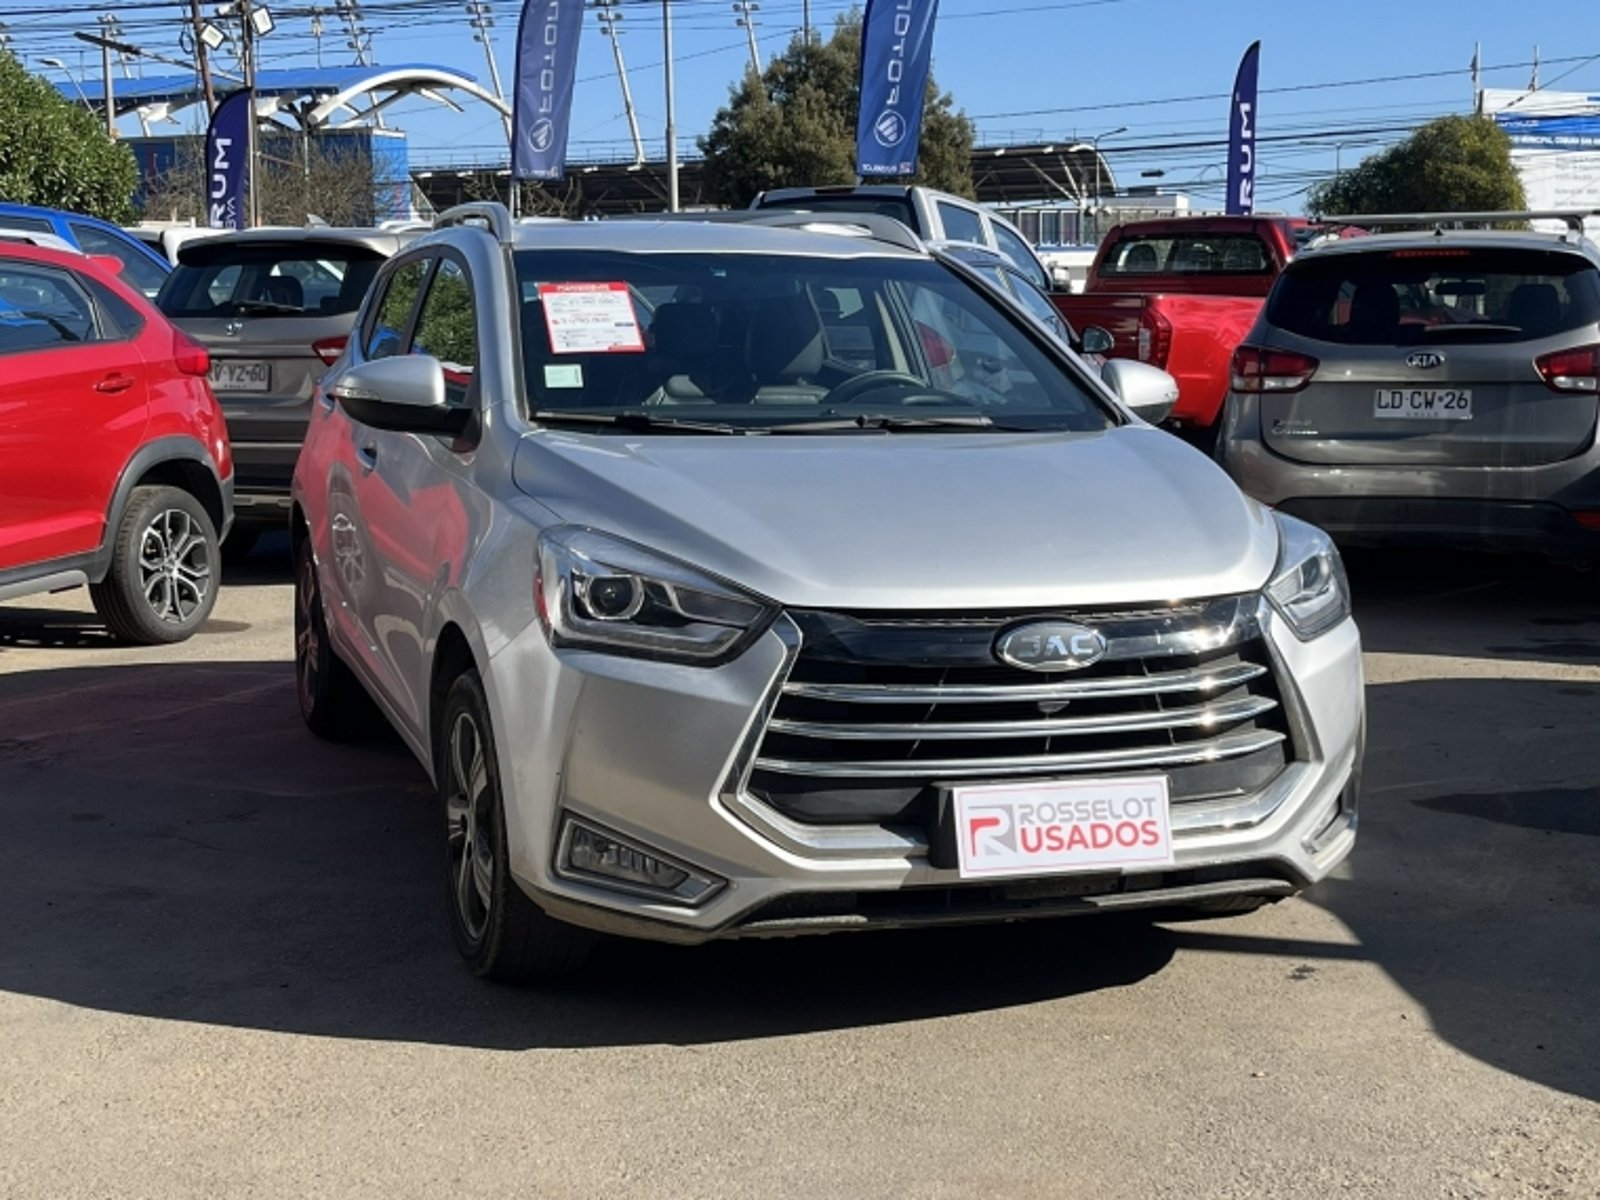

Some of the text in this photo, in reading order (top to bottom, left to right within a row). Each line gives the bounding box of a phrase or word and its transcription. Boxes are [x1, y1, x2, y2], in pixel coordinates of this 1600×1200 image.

[1239, 102, 1252, 216] RUM
[1412, 353, 1438, 365] KIA
[1017, 634, 1094, 657] JAC
[1018, 797, 1156, 826] ROSSELOT
[1020, 820, 1160, 854] USADOS
